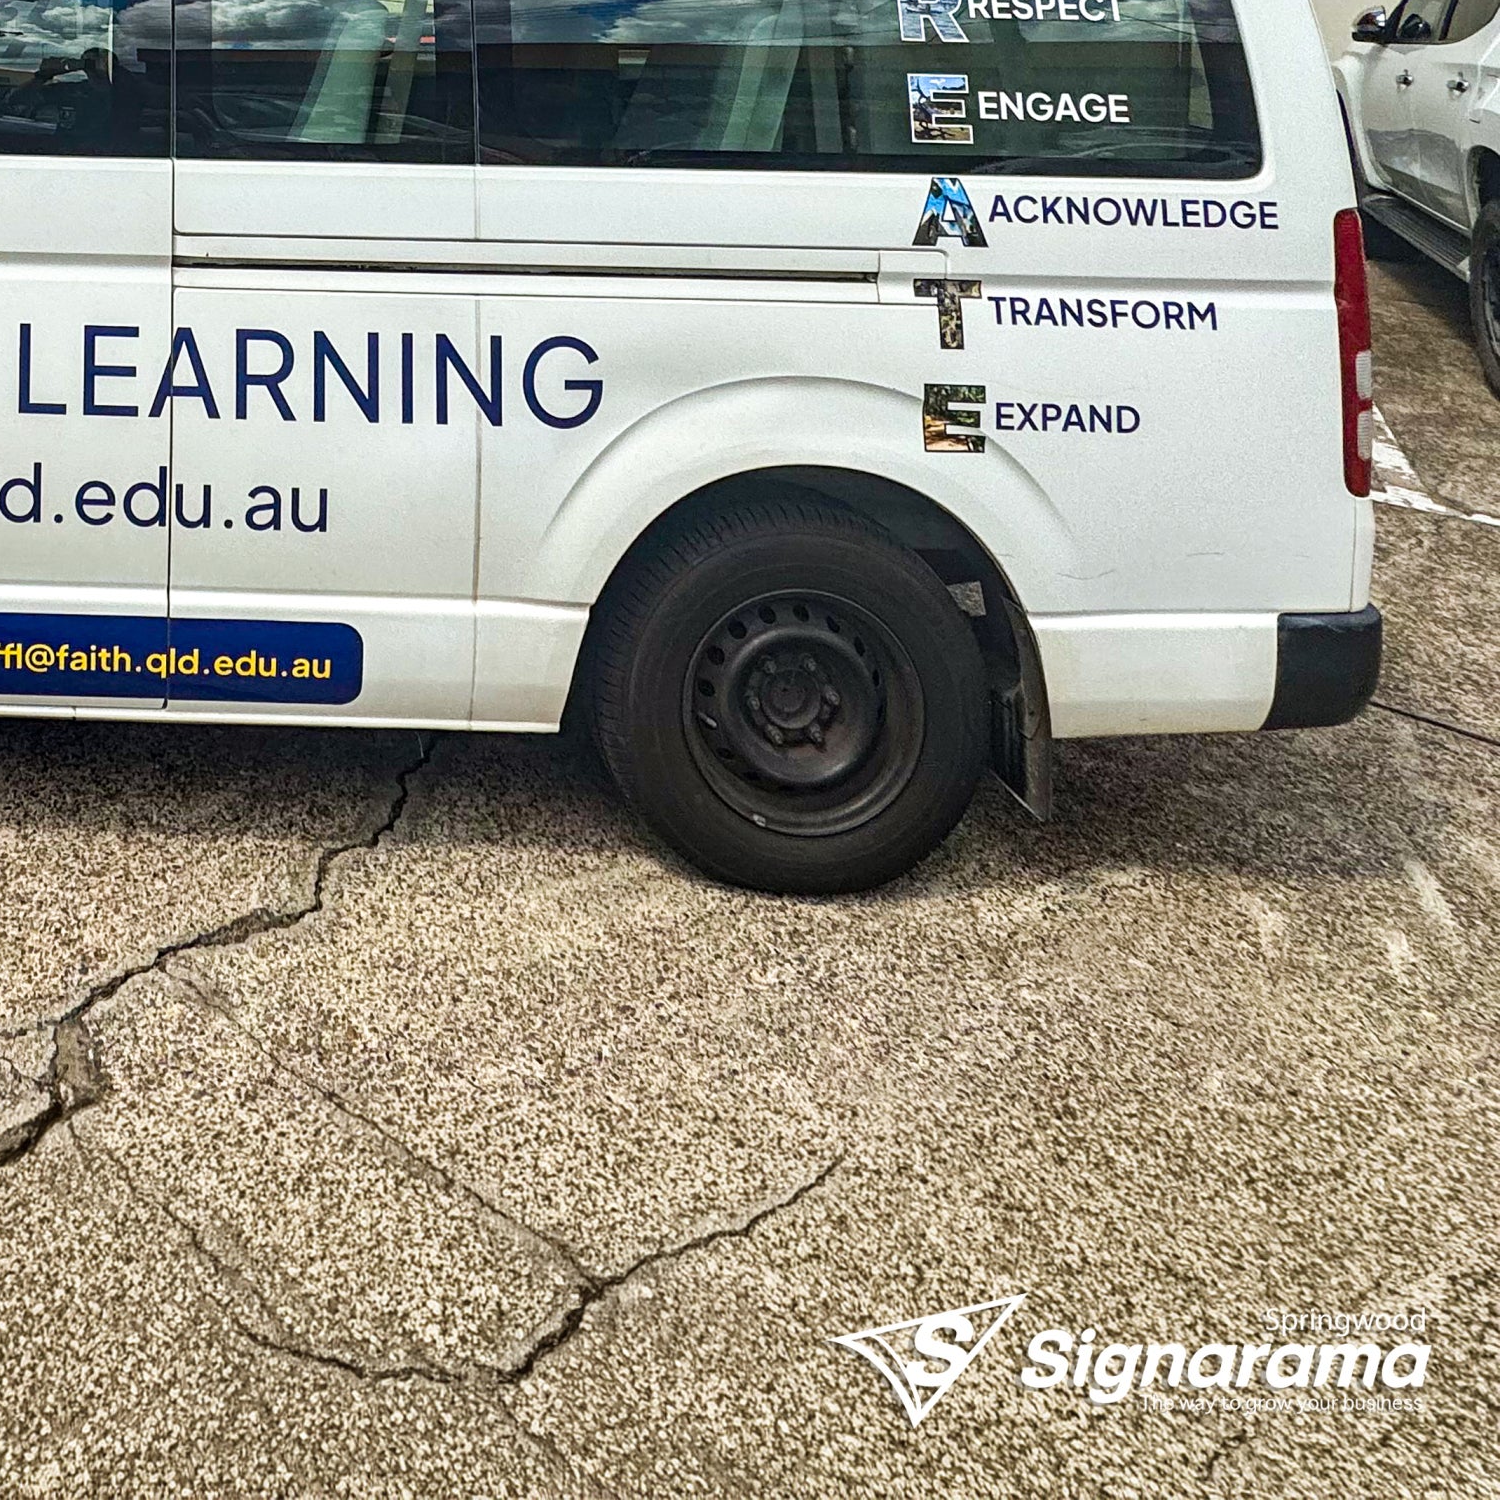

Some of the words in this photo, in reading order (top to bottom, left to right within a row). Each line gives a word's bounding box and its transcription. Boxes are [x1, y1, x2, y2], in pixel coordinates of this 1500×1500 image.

[907, 73, 974, 145] E
[978, 91, 1130, 123] ENGAGE
[912, 177, 989, 248] A
[989, 194, 1279, 230] ACKNOWLEDGE
[913, 278, 982, 350] T
[988, 296, 1218, 331] TRANSFORM
[18, 322, 604, 430] LEARNING
[923, 383, 986, 453] E
[996, 402, 1140, 434] EXPAND
